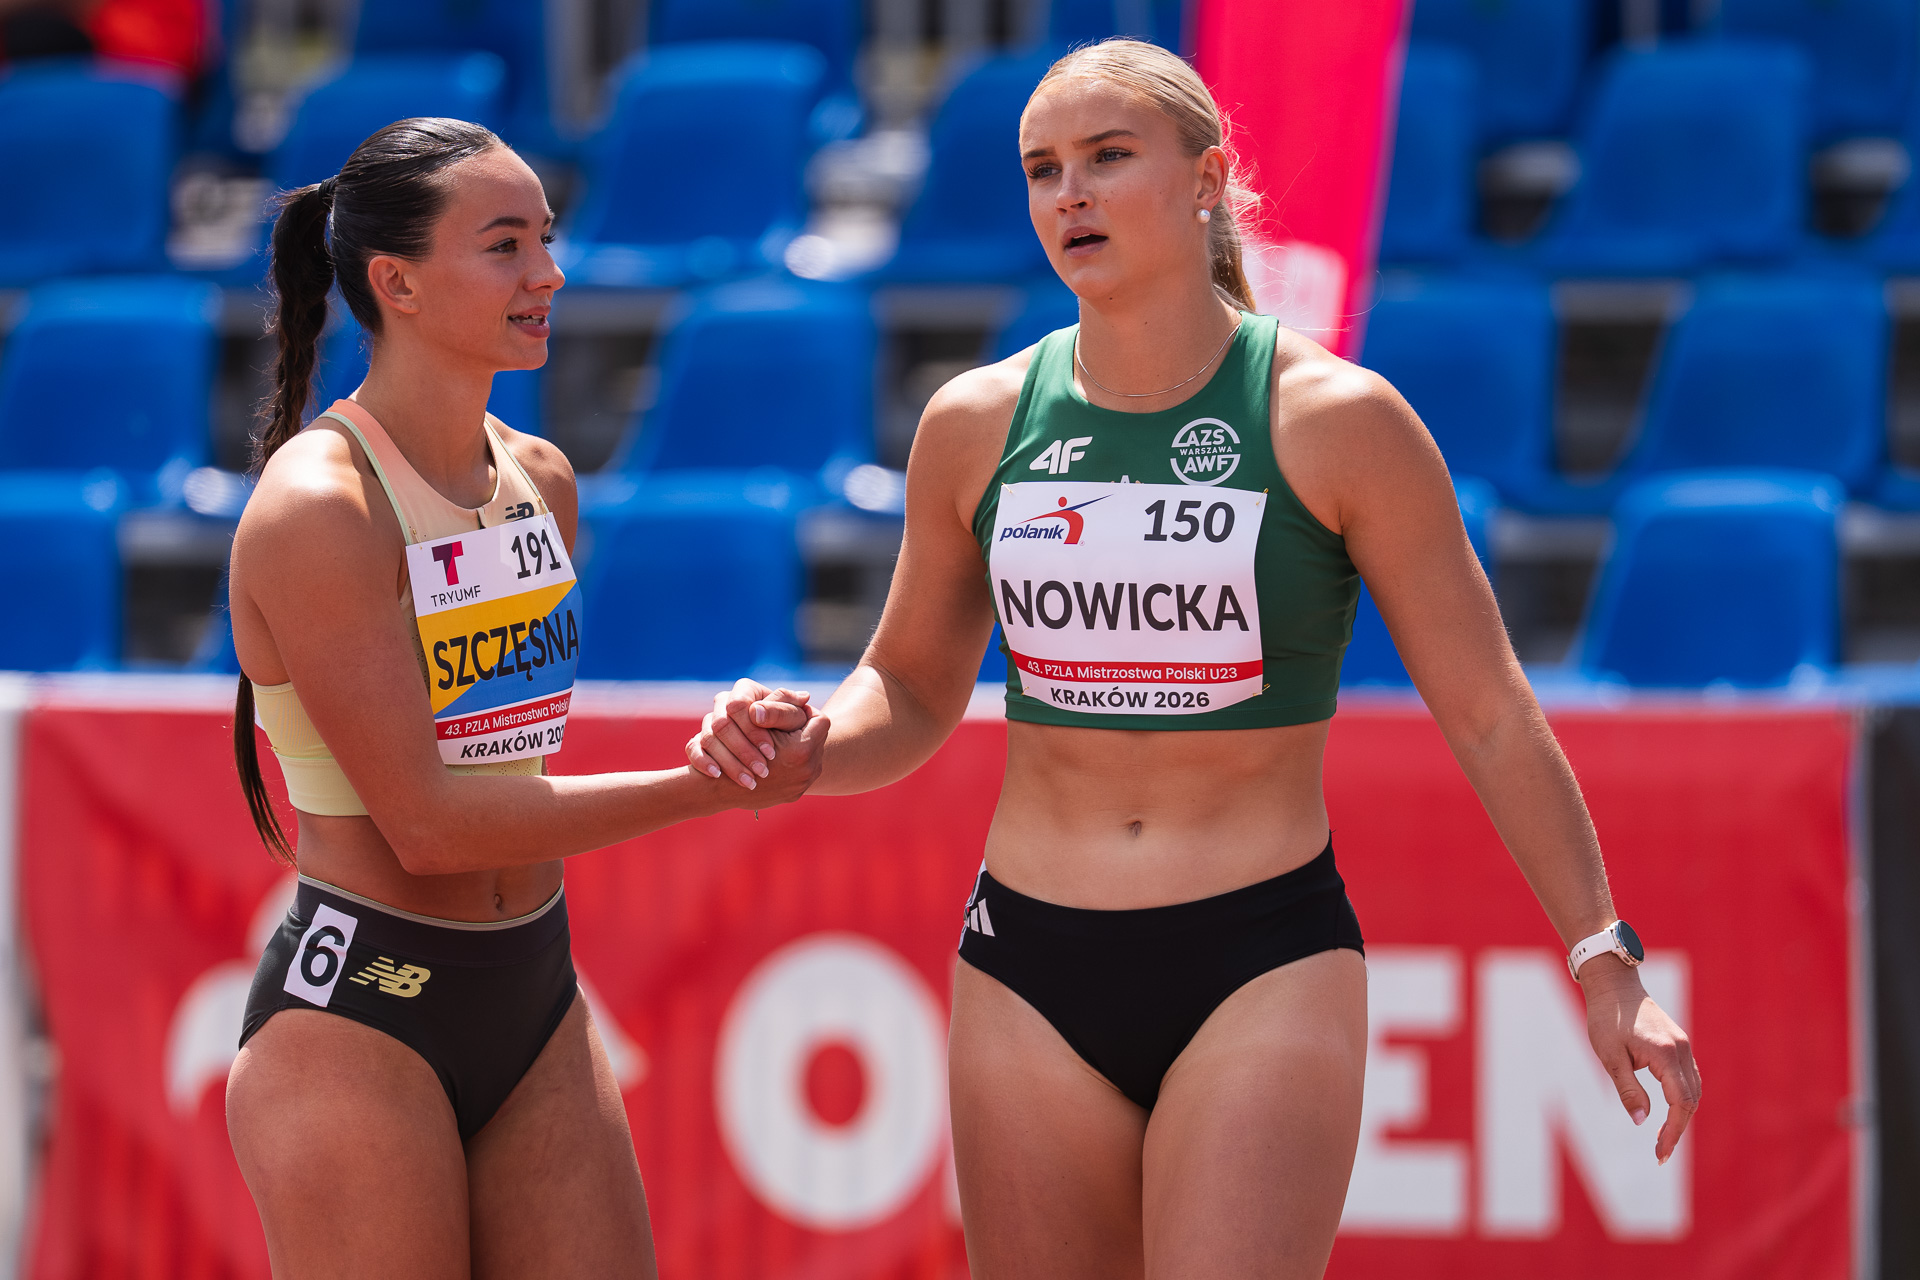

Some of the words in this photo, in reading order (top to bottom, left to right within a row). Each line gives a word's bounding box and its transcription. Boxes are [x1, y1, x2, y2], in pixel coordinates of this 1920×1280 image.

[1180, 446, 1233, 456] WARSZAWA
[1185, 429, 1226, 447] AZS
[1029, 436, 1093, 475] 4F
[1183, 453, 1229, 474] AWF
[999, 524, 1064, 542] polanik
[1144, 500, 1235, 543] 150
[511, 528, 562, 580] 191
[431, 585, 482, 607] TRYUMF
[1000, 579, 1250, 632] NOWICKA
[433, 609, 579, 691] SZCZĘSNA
[1027, 660, 1043, 675] 43.
[1044, 664, 1074, 679] PZLA
[1077, 666, 1162, 679] Mistrzostwa
[1166, 667, 1206, 680] Polski
[1210, 667, 1238, 680] U23
[1050, 686, 1148, 708] KRAKÓW
[1154, 691, 1210, 708] 2026
[445, 723, 462, 736] 43.
[465, 719, 491, 734] PZLA
[493, 706, 549, 729] Mistrzostwa
[460, 730, 544, 758] KRAKÓW
[300, 925, 346, 987] 6
